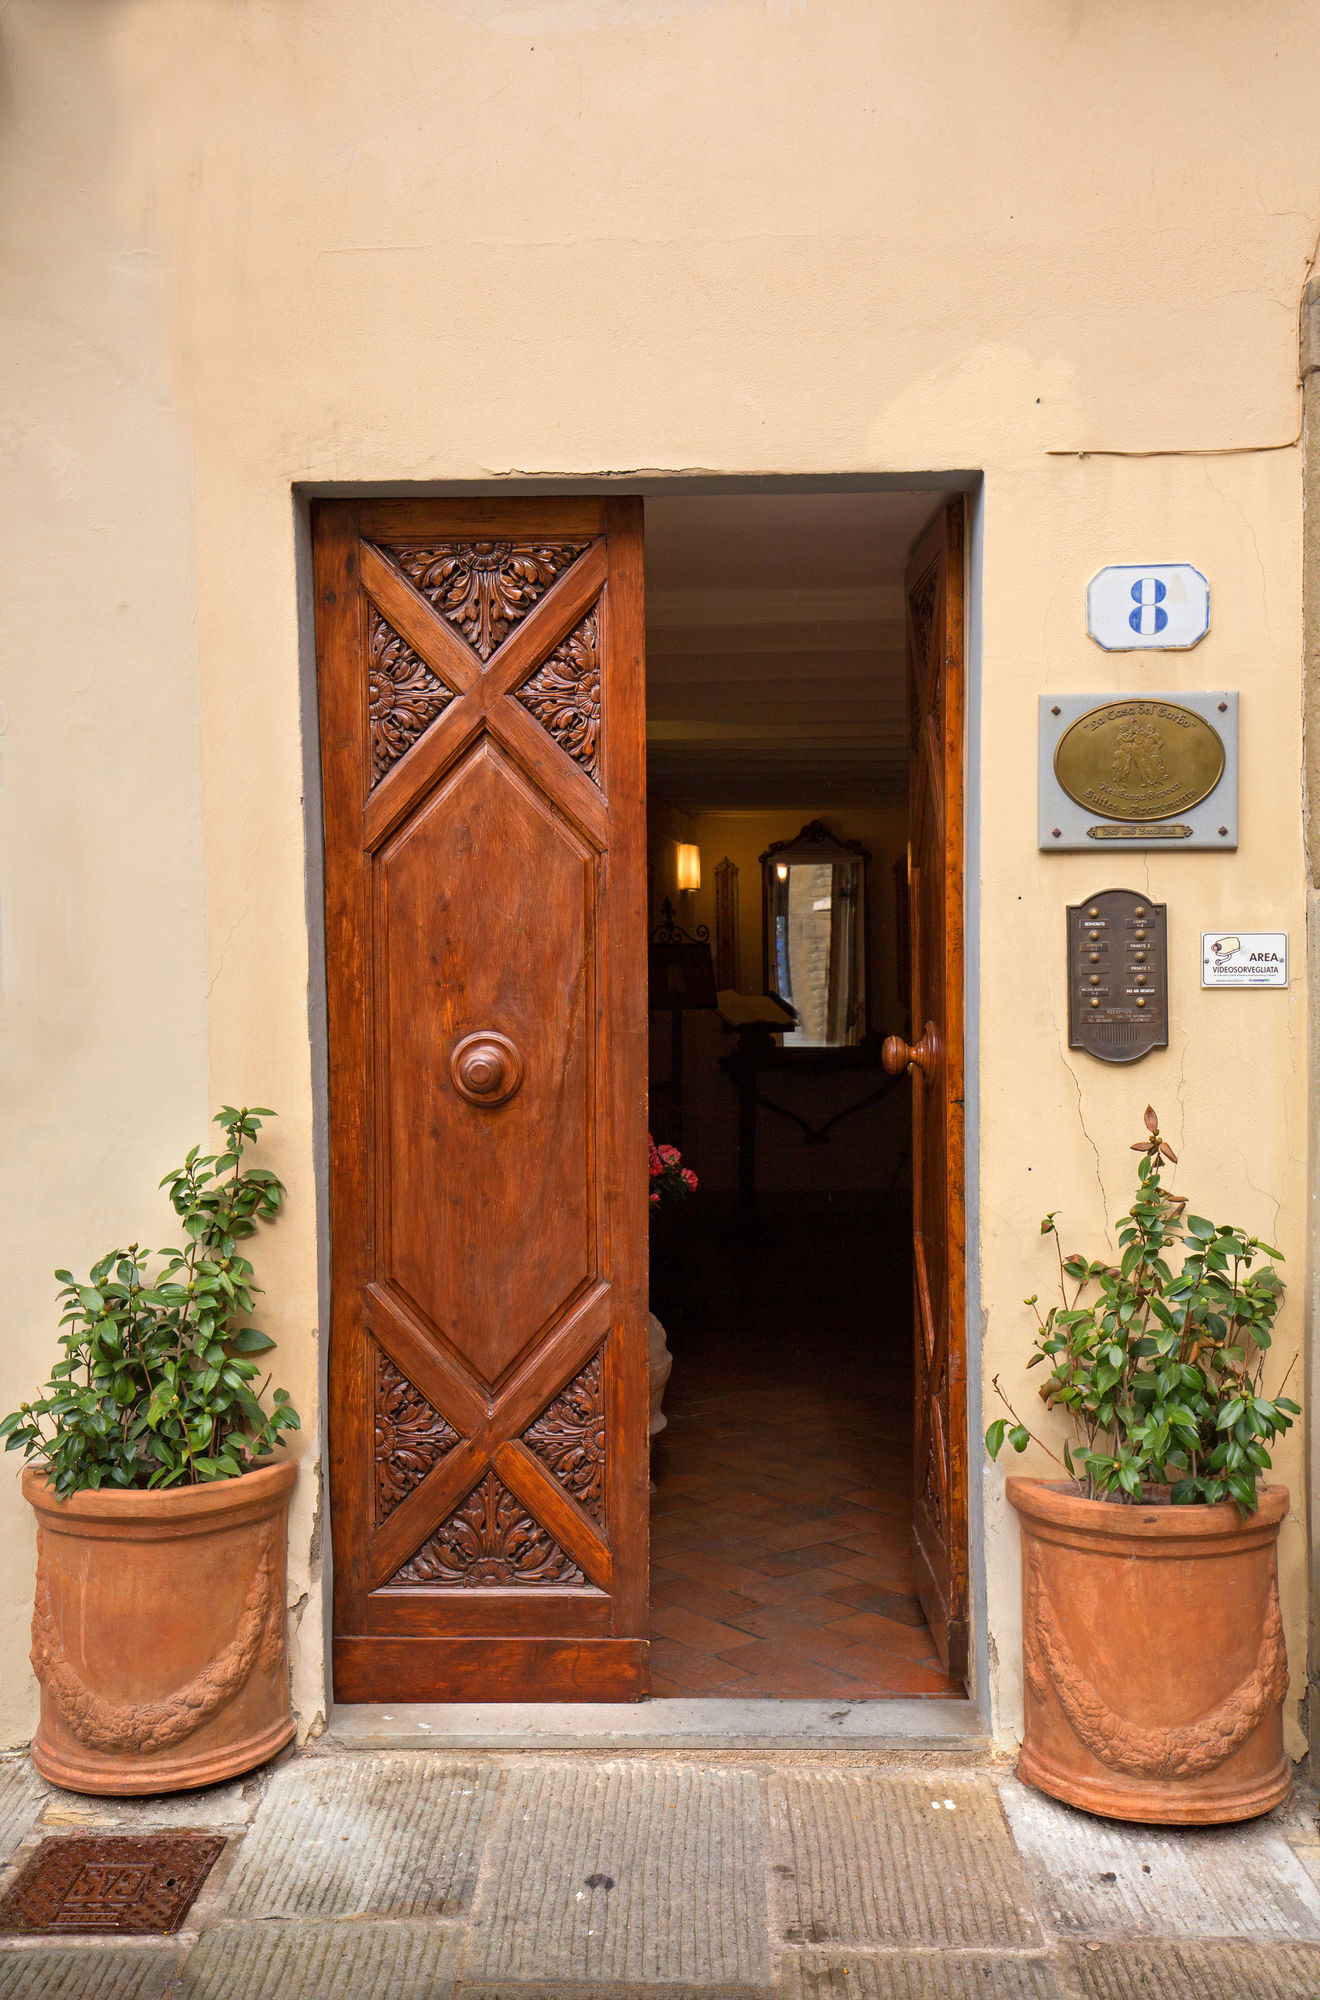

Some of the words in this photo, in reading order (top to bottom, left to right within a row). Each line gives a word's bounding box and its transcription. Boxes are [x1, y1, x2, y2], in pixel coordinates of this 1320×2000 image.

[1128, 577, 1168, 636] 8
[1106, 707, 1135, 720] Casa
[1137, 704, 1156, 715] del
[1083, 788, 1119, 811] Suites
[1249, 952, 1279, 962] AREA
[1212, 966, 1279, 974] VIDEOSORVEGLIATA
